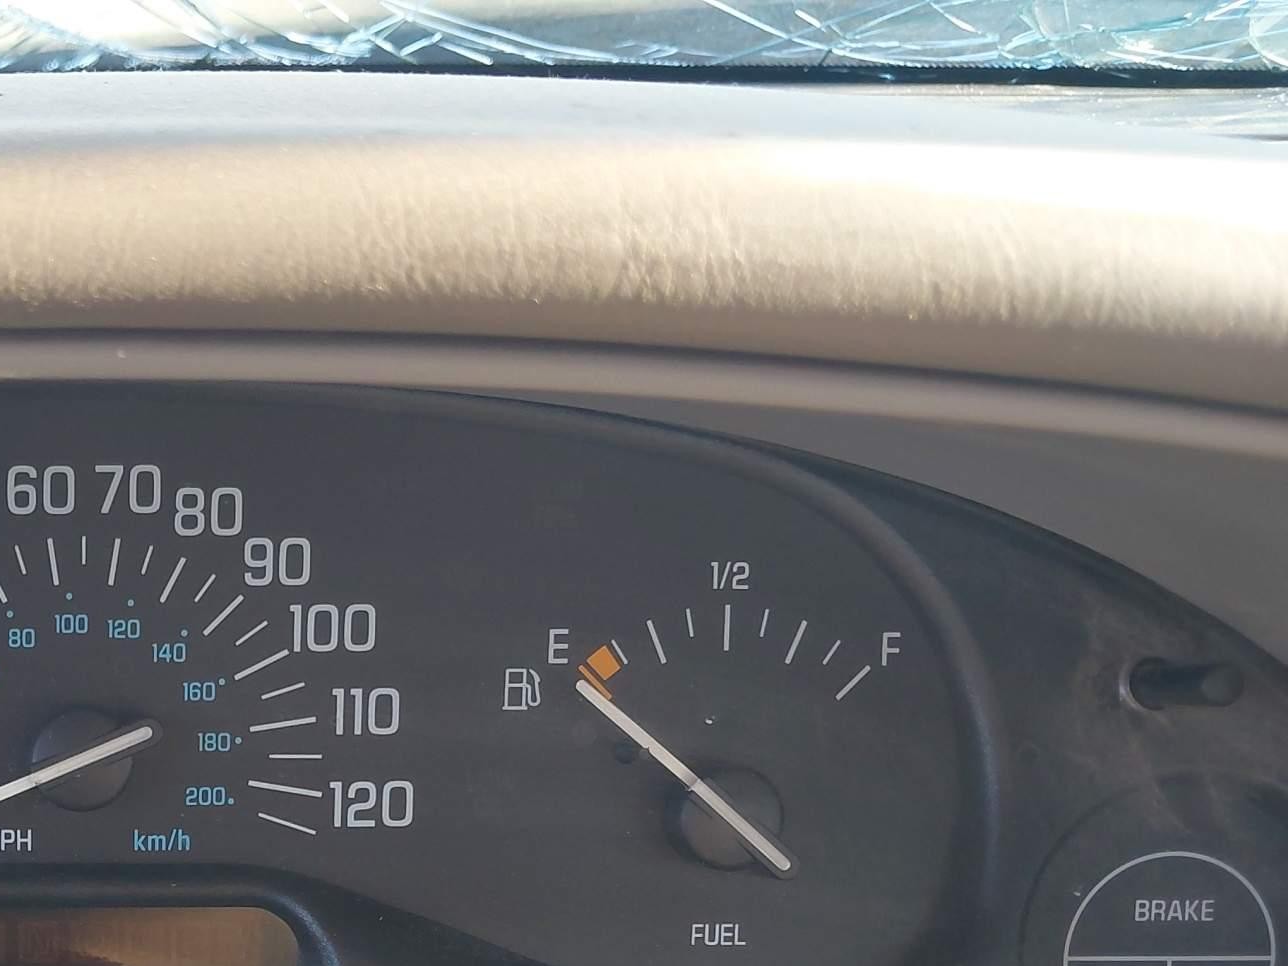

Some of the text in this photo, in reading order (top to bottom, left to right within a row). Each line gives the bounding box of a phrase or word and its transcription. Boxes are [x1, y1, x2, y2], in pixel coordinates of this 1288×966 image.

[6, 465, 75, 515] 60
[94, 464, 162, 514] 70
[174, 487, 243, 537] 80
[244, 537, 311, 587] 90
[710, 561, 750, 590] 1/2
[54, 614, 89, 634] 100
[107, 619, 141, 639] 120
[288, 602, 377, 653] 100
[8, 628, 36, 648] 80
[547, 628, 569, 664] E
[881, 631, 901, 667] F
[151, 642, 186, 663] 140
[182, 681, 216, 702] 160
[332, 687, 400, 736] 110
[197, 732, 231, 752] 180
[185, 786, 226, 806] 200
[329, 780, 414, 828] 120
[134, 828, 191, 852] km/h
[1134, 899, 1215, 922] BRAKE
[691, 923, 747, 946] FUEL
